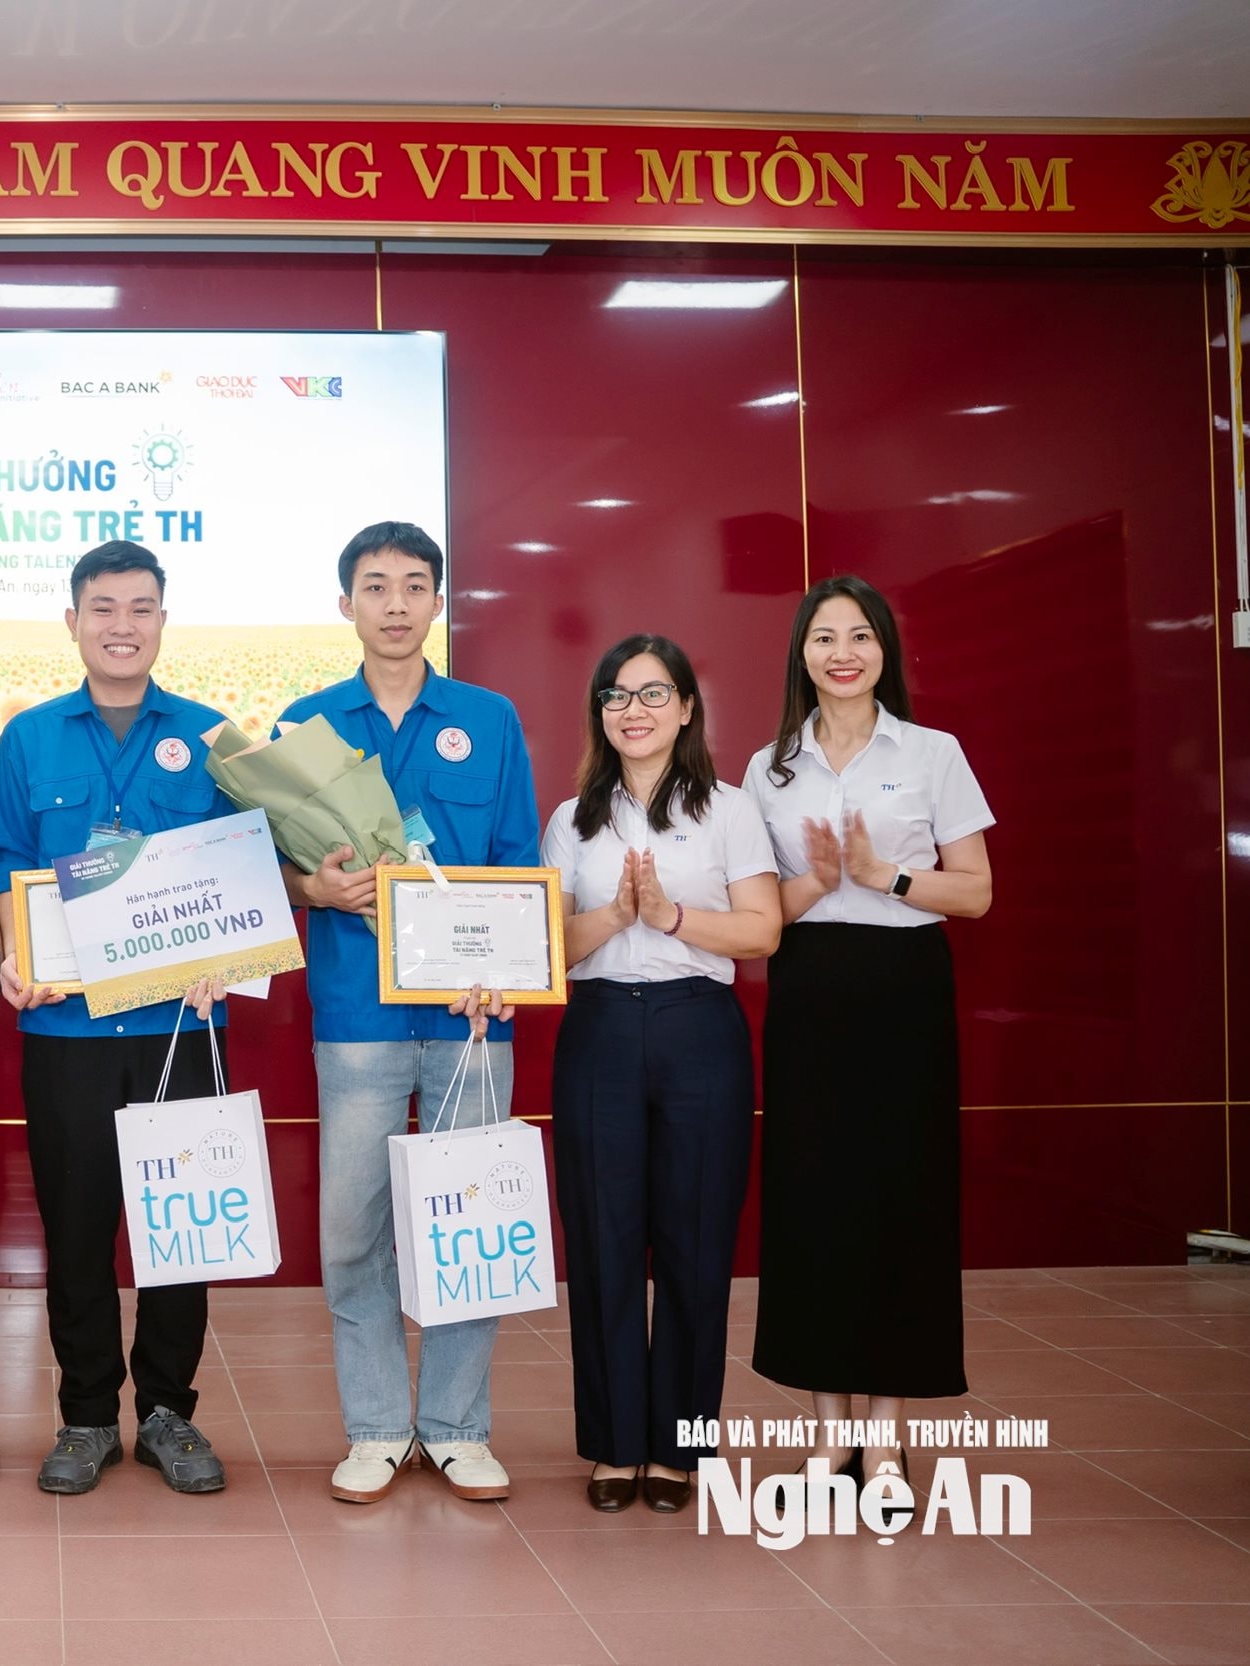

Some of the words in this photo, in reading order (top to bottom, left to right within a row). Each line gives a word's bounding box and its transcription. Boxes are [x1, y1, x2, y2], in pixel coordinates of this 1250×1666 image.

[107, 140, 381, 210] QUANG
[401, 143, 609, 203] VINH
[636, 136, 868, 209] MUÔN
[897, 142, 1074, 212] NĂM
[61, 381, 94, 394] BAC
[98, 381, 110, 394] A
[115, 381, 161, 394] BANK
[73, 500, 144, 543] TRẺ
[155, 510, 203, 542] TH
[132, 904, 169, 929] GIẢI
[174, 890, 223, 921] NHẤT
[172, 884, 192, 894] trao
[104, 921, 210, 963] 5.000.000
[214, 909, 264, 936] VNĐ
[137, 1157, 177, 1181] TH
[140, 1186, 249, 1231] true
[424, 1192, 463, 1217] TH
[149, 1223, 255, 1268] MILK
[428, 1220, 536, 1267] true
[436, 1256, 541, 1307] MILK
